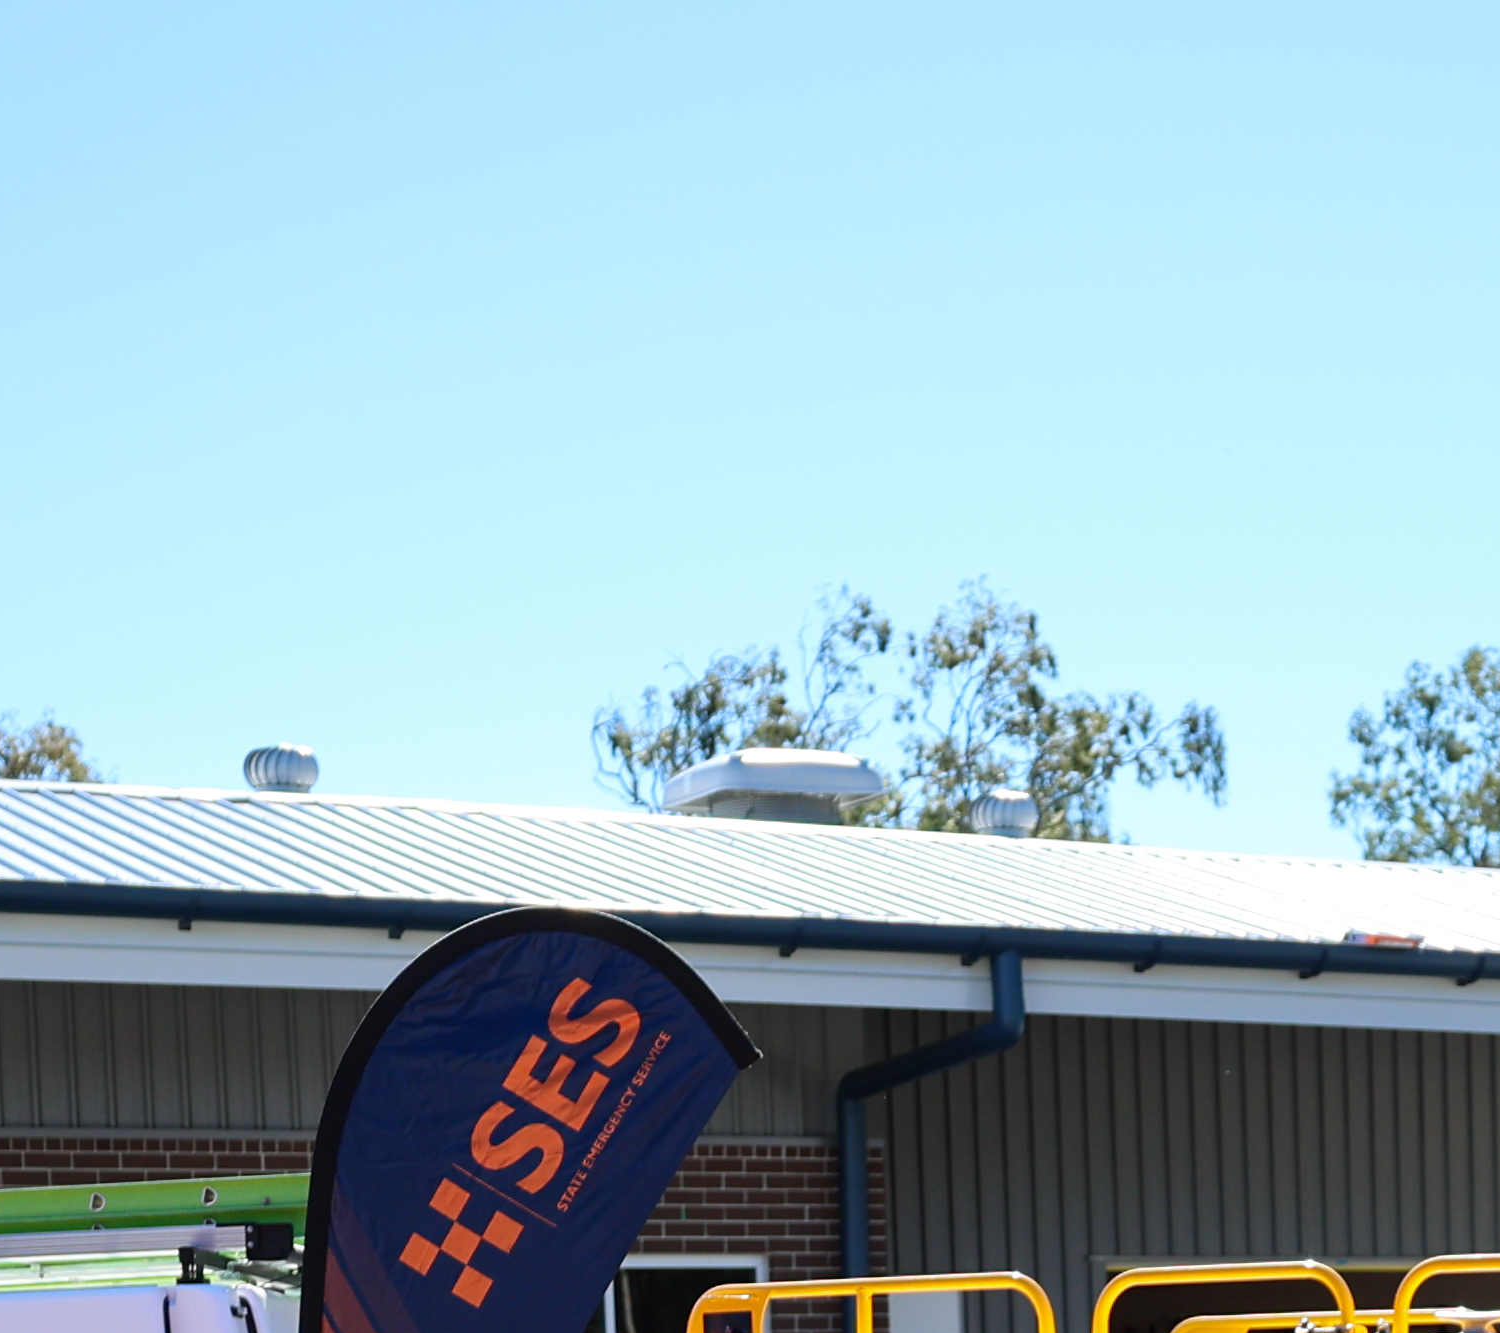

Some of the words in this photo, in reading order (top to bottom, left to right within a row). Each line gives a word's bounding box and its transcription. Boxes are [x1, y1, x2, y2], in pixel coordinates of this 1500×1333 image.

[471, 977, 642, 1194] SES
[556, 1169, 588, 1212] STATE
[584, 1087, 636, 1168] EMERGENCY
[632, 1031, 672, 1087] SERVICE
